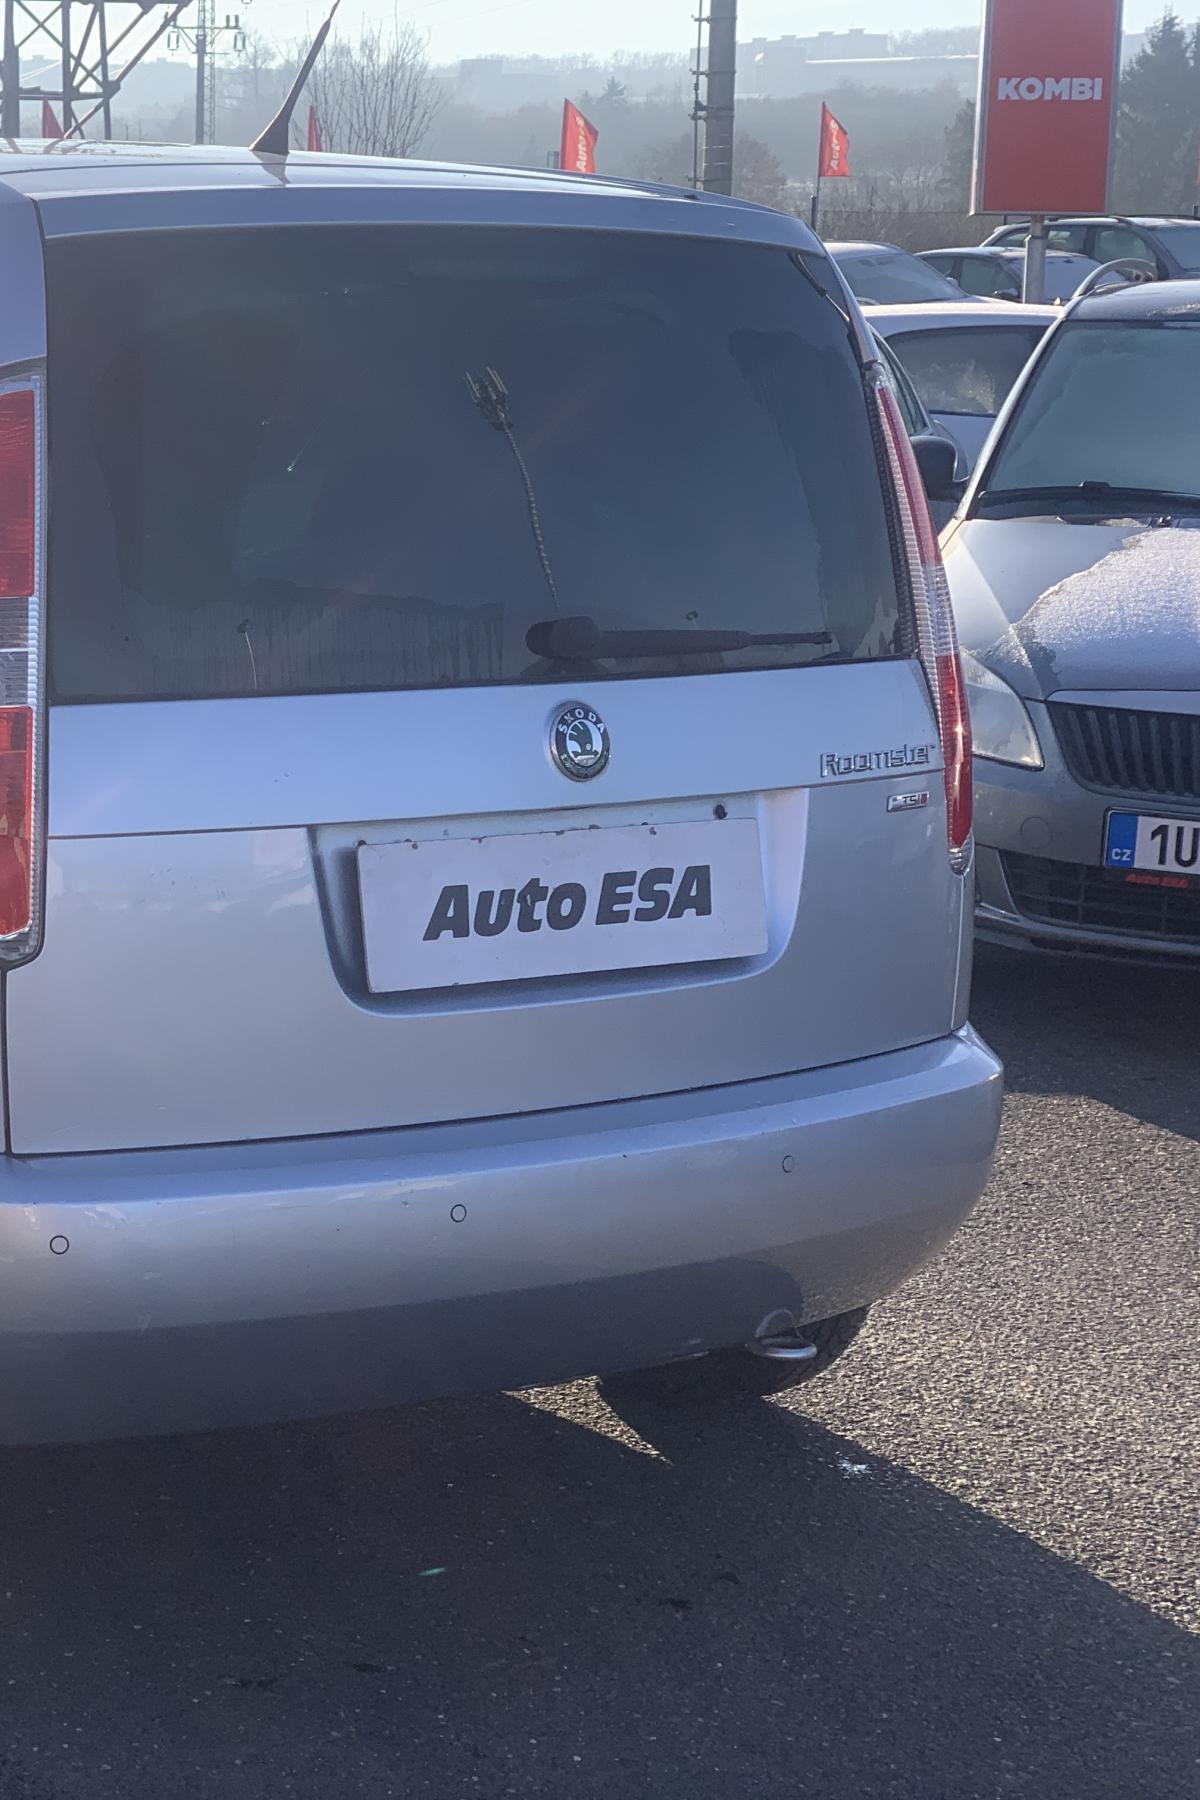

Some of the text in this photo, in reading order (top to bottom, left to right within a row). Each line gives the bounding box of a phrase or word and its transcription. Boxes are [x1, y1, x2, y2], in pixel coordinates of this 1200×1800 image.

[998, 77, 1103, 101] KOMBI
[820, 744, 936, 778] Roomster
[1111, 848, 1132, 861] CZ
[1151, 824, 1200, 868] 1U
[423, 865, 712, 941] Auto ESA
